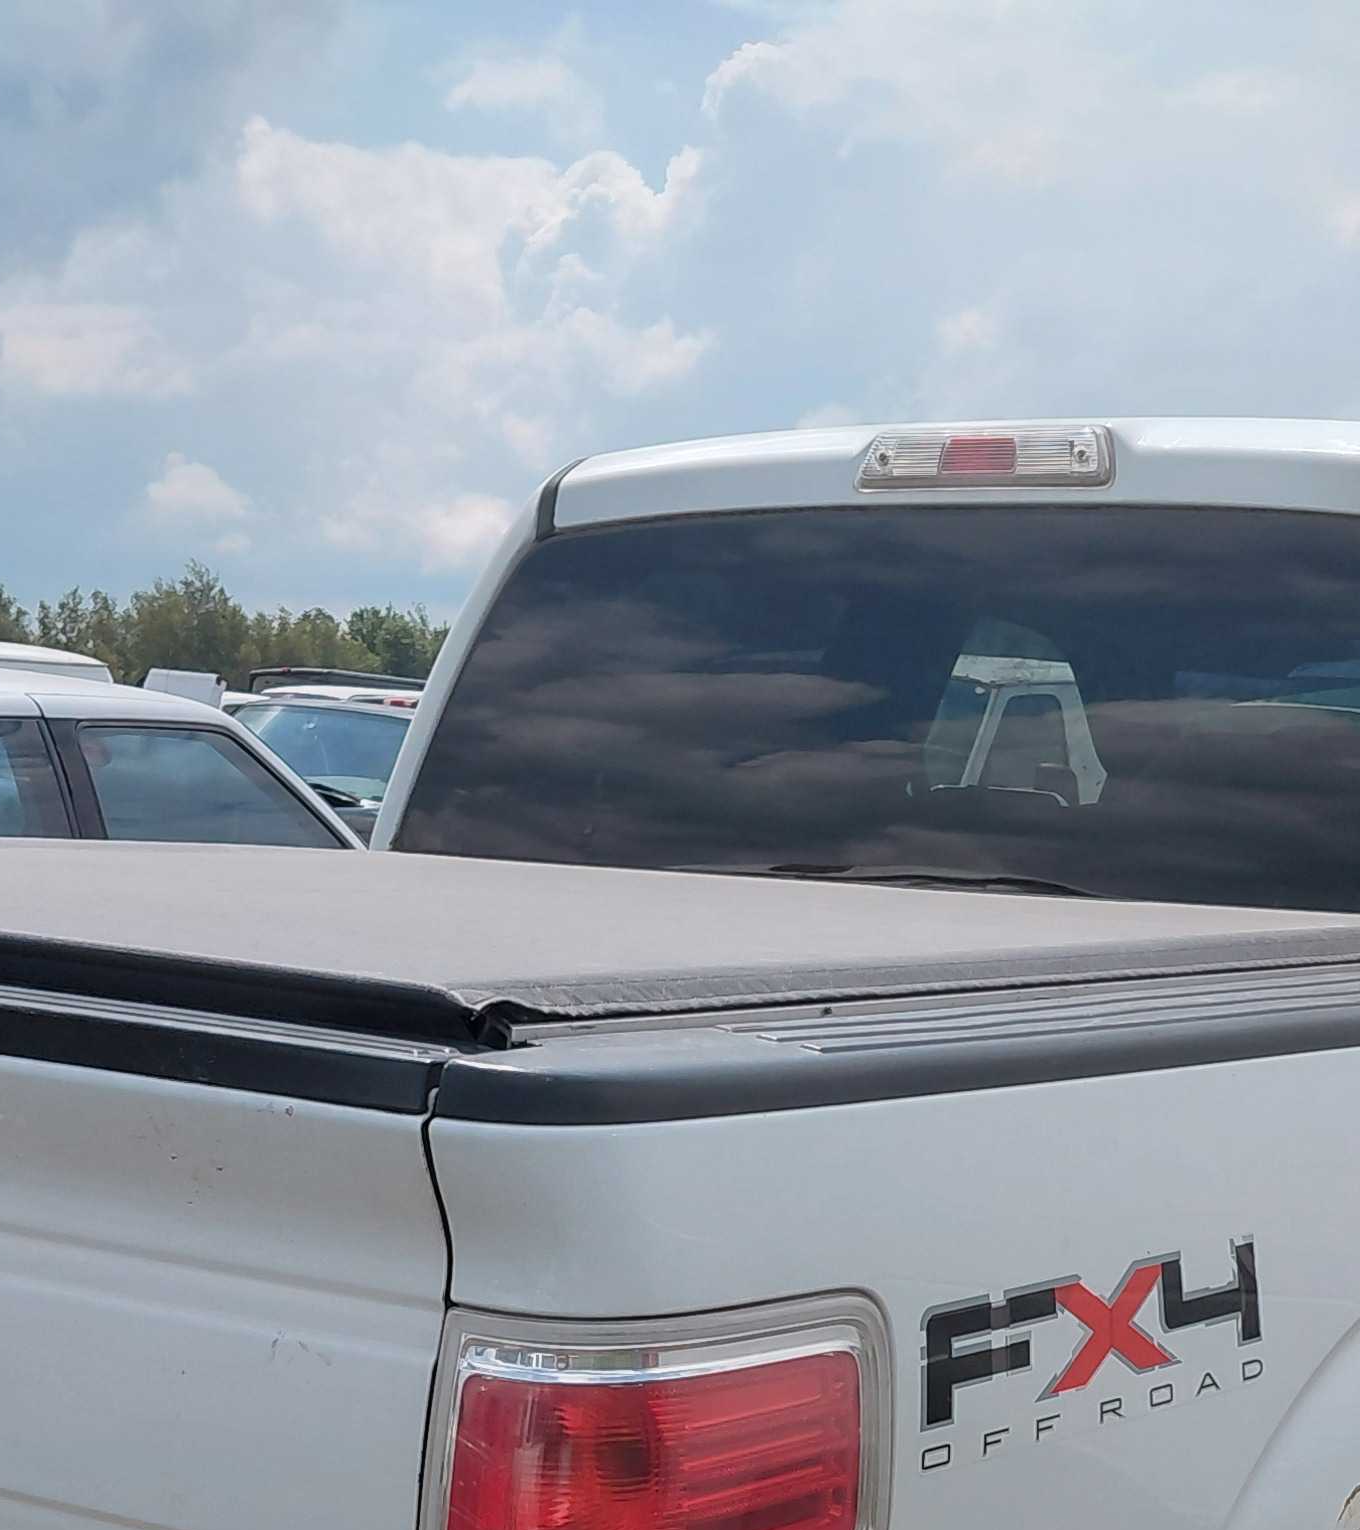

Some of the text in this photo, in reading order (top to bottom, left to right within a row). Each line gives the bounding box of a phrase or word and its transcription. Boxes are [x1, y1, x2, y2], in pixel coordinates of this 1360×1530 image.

[920, 1234, 1262, 1432] FX4
[921, 1358, 1264, 1470] OFF ROAD
